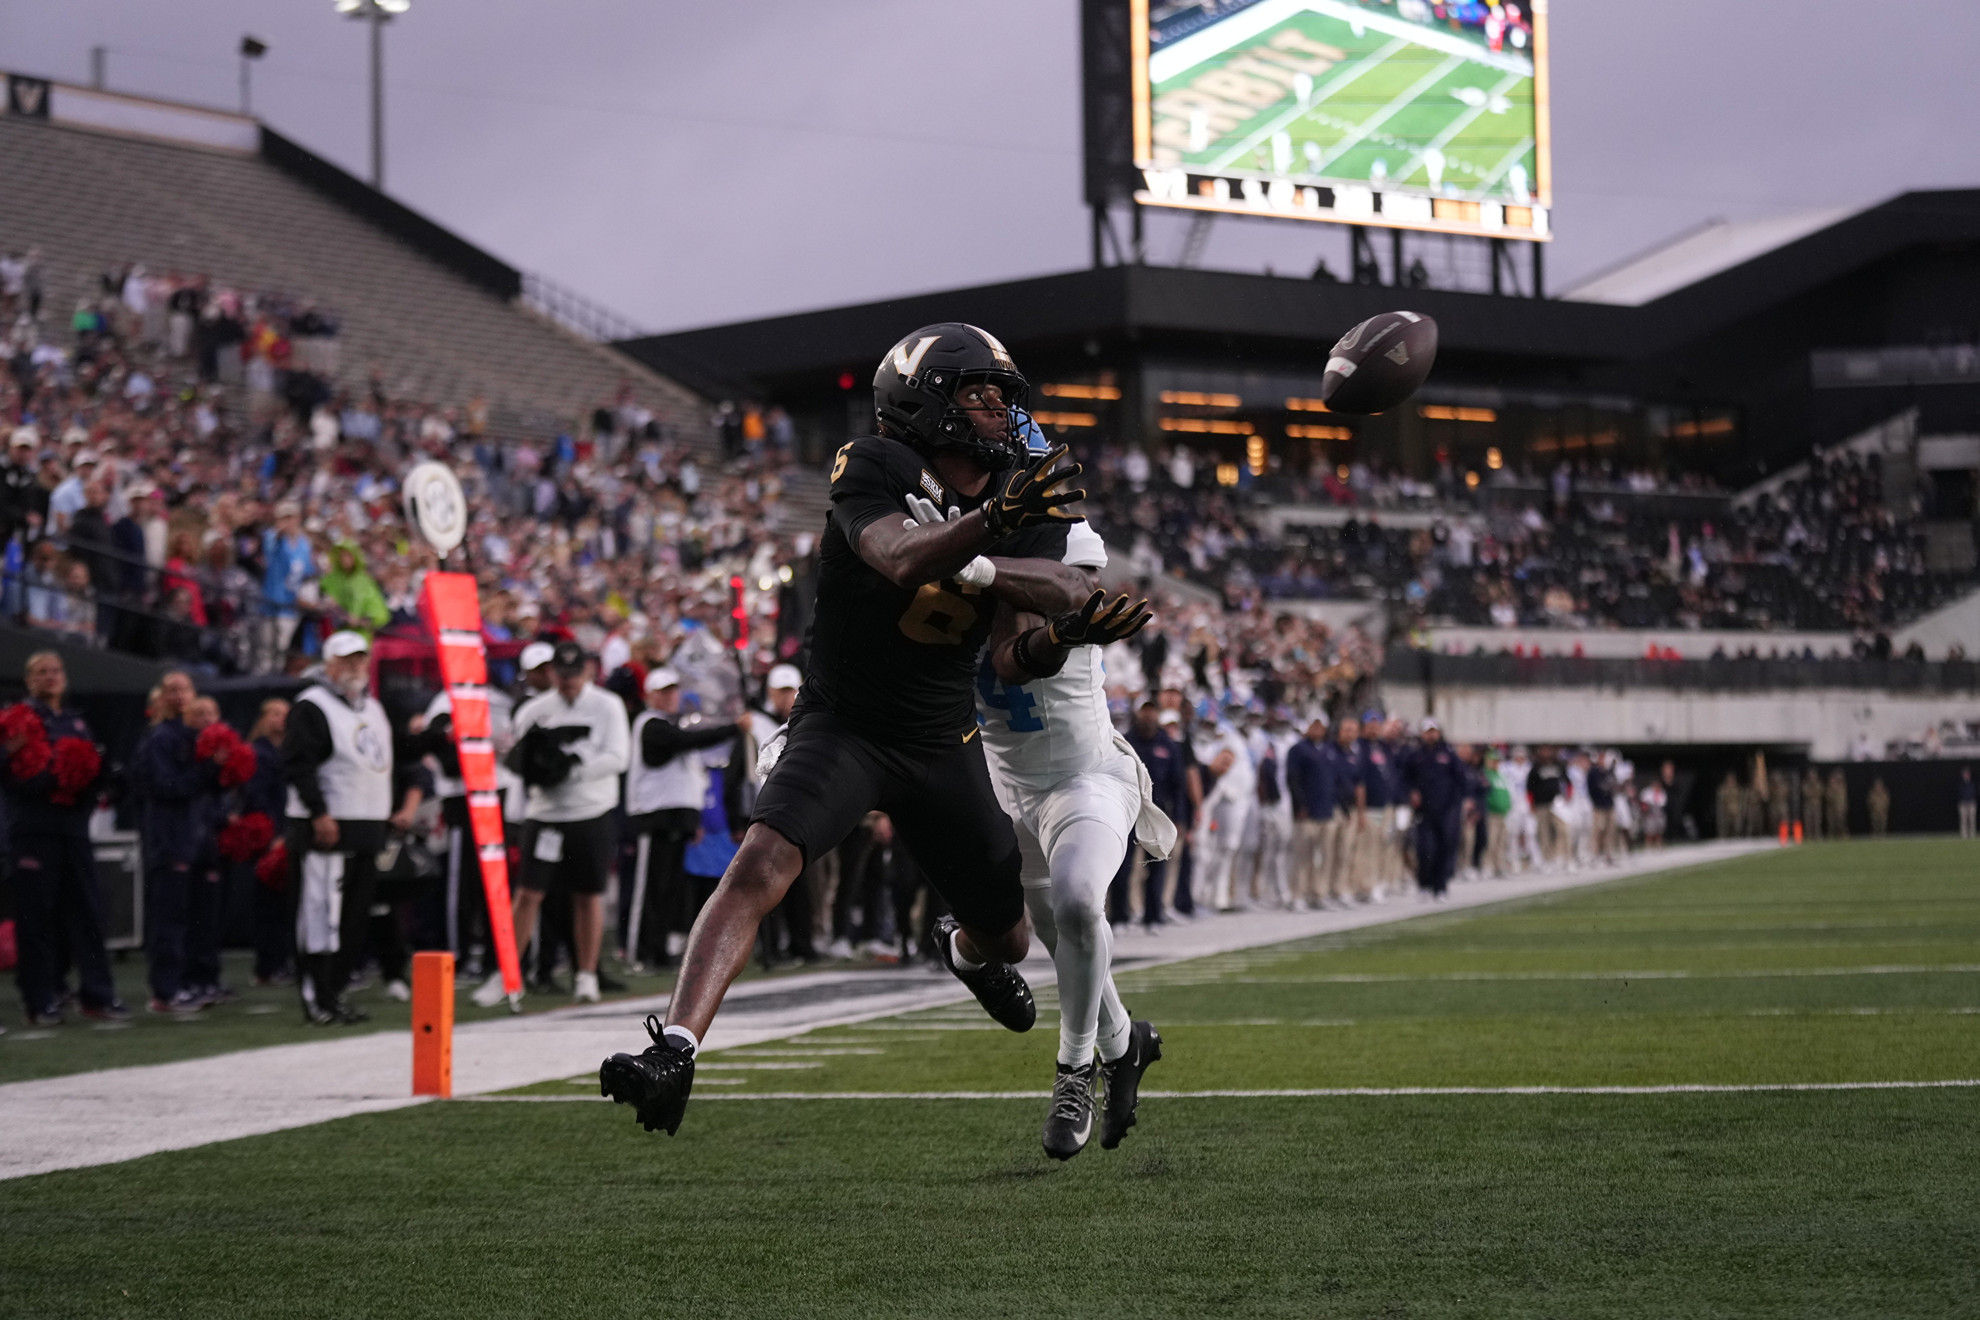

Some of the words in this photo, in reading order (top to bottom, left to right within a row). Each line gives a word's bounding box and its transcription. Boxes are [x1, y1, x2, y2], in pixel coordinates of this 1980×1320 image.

[893, 335, 943, 377] V
[831, 441, 855, 484] 6
[898, 580, 979, 645] 6
[976, 645, 1044, 733] 4
